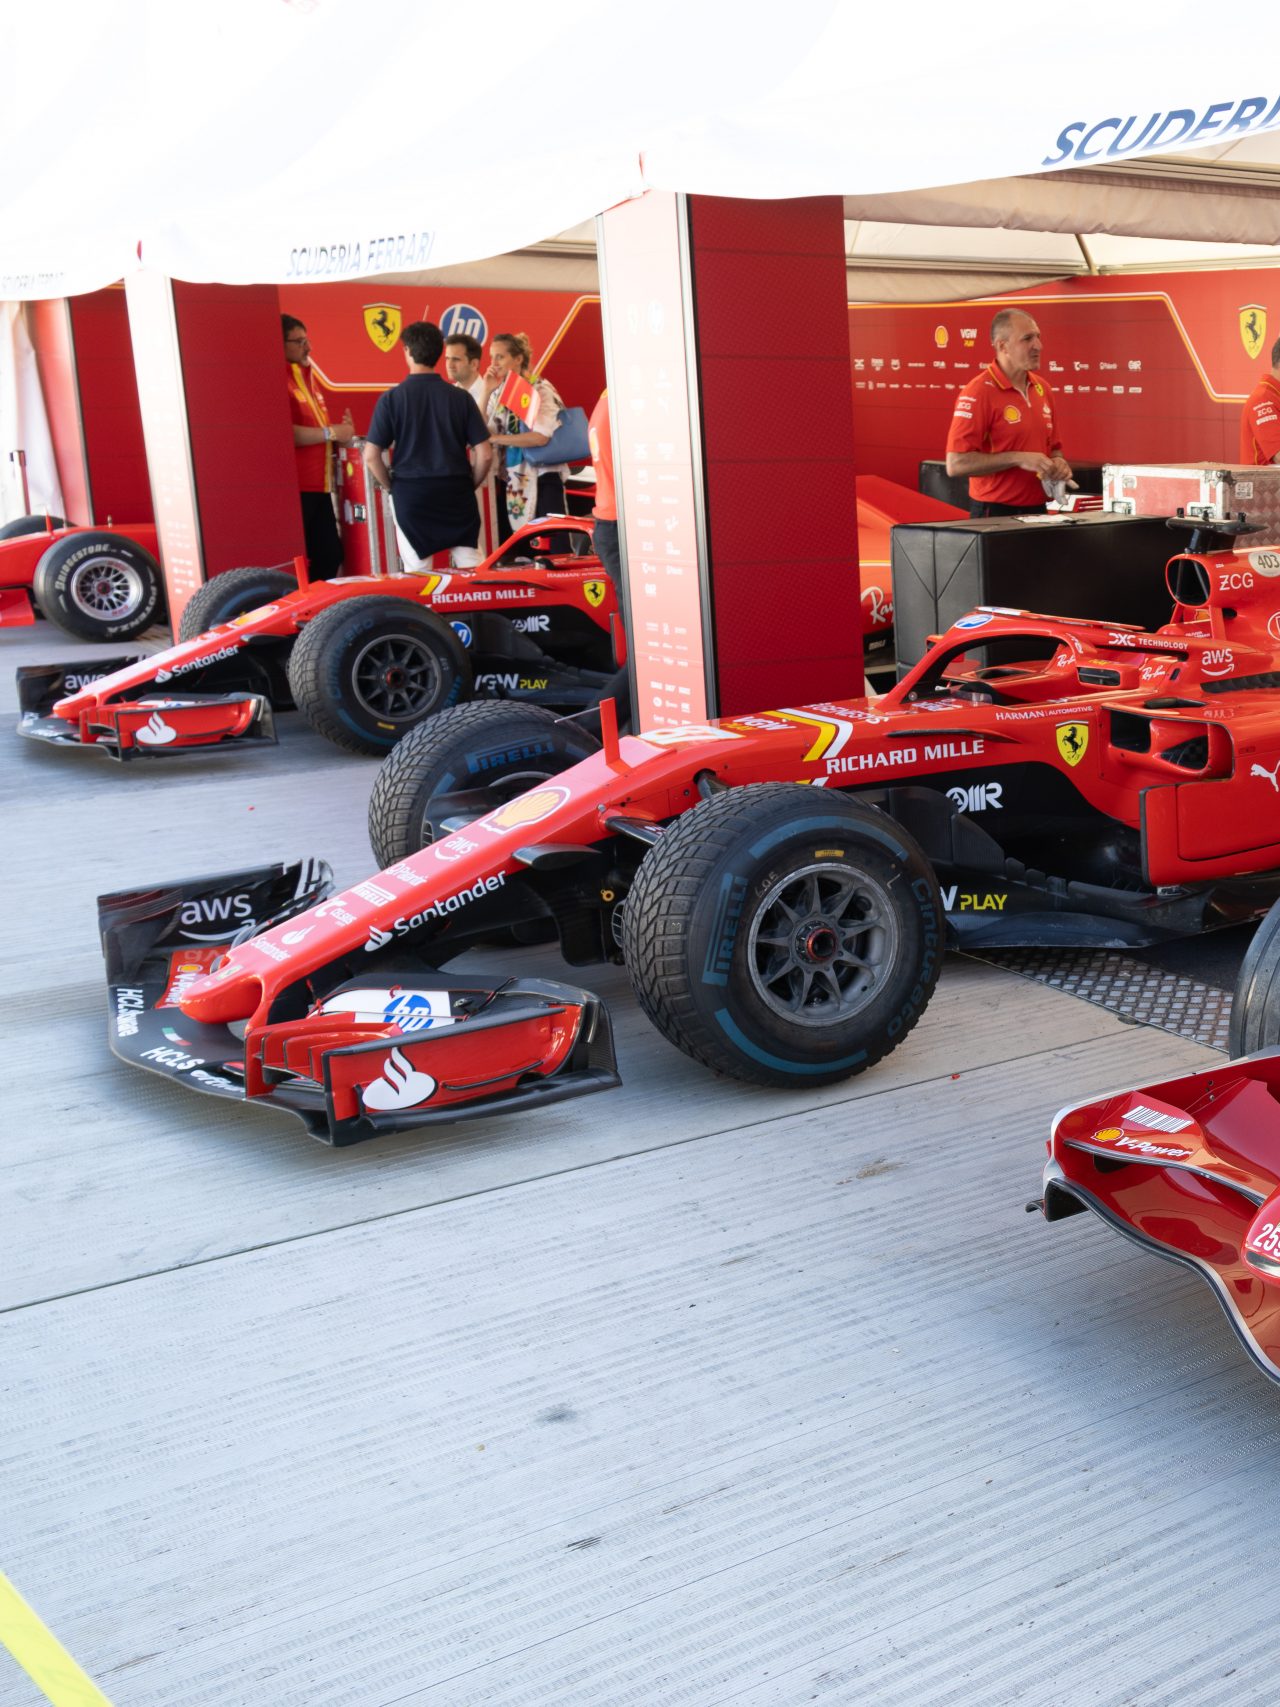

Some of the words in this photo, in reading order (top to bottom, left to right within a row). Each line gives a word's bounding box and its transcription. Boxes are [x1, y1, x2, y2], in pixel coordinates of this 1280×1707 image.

[286, 242, 361, 277] SCUDERIA
[366, 231, 437, 271] FERRARI
[1257, 554, 1280, 570] 403
[1219, 573, 1254, 592] ZCG
[432, 590, 491, 604] RICHARD
[496, 588, 536, 600] MILLE
[1109, 632, 1136, 647] DXC
[1138, 638, 1189, 650] TECHNOLOGY
[172, 645, 240, 676] Santander
[1202, 648, 1234, 666] aws
[520, 679, 548, 689] PLAY
[995, 710, 1046, 721] HARMAN
[1048, 705, 1093, 716] AUTOMOTIVE
[463, 734, 555, 775] PIRELLI
[826, 747, 918, 775] RICHARD
[924, 739, 985, 762] MILLE
[444, 836, 480, 855] aws
[350, 881, 397, 907] PIRELLI
[393, 869, 508, 937] Santander
[960, 893, 1008, 911] PLAY
[180, 894, 252, 925] aws
[701, 872, 749, 988] PIRELLI
[250, 936, 292, 962] Santander
[887, 877, 940, 1039] Cinturato
[1113, 1135, 1194, 1158] V-Power
